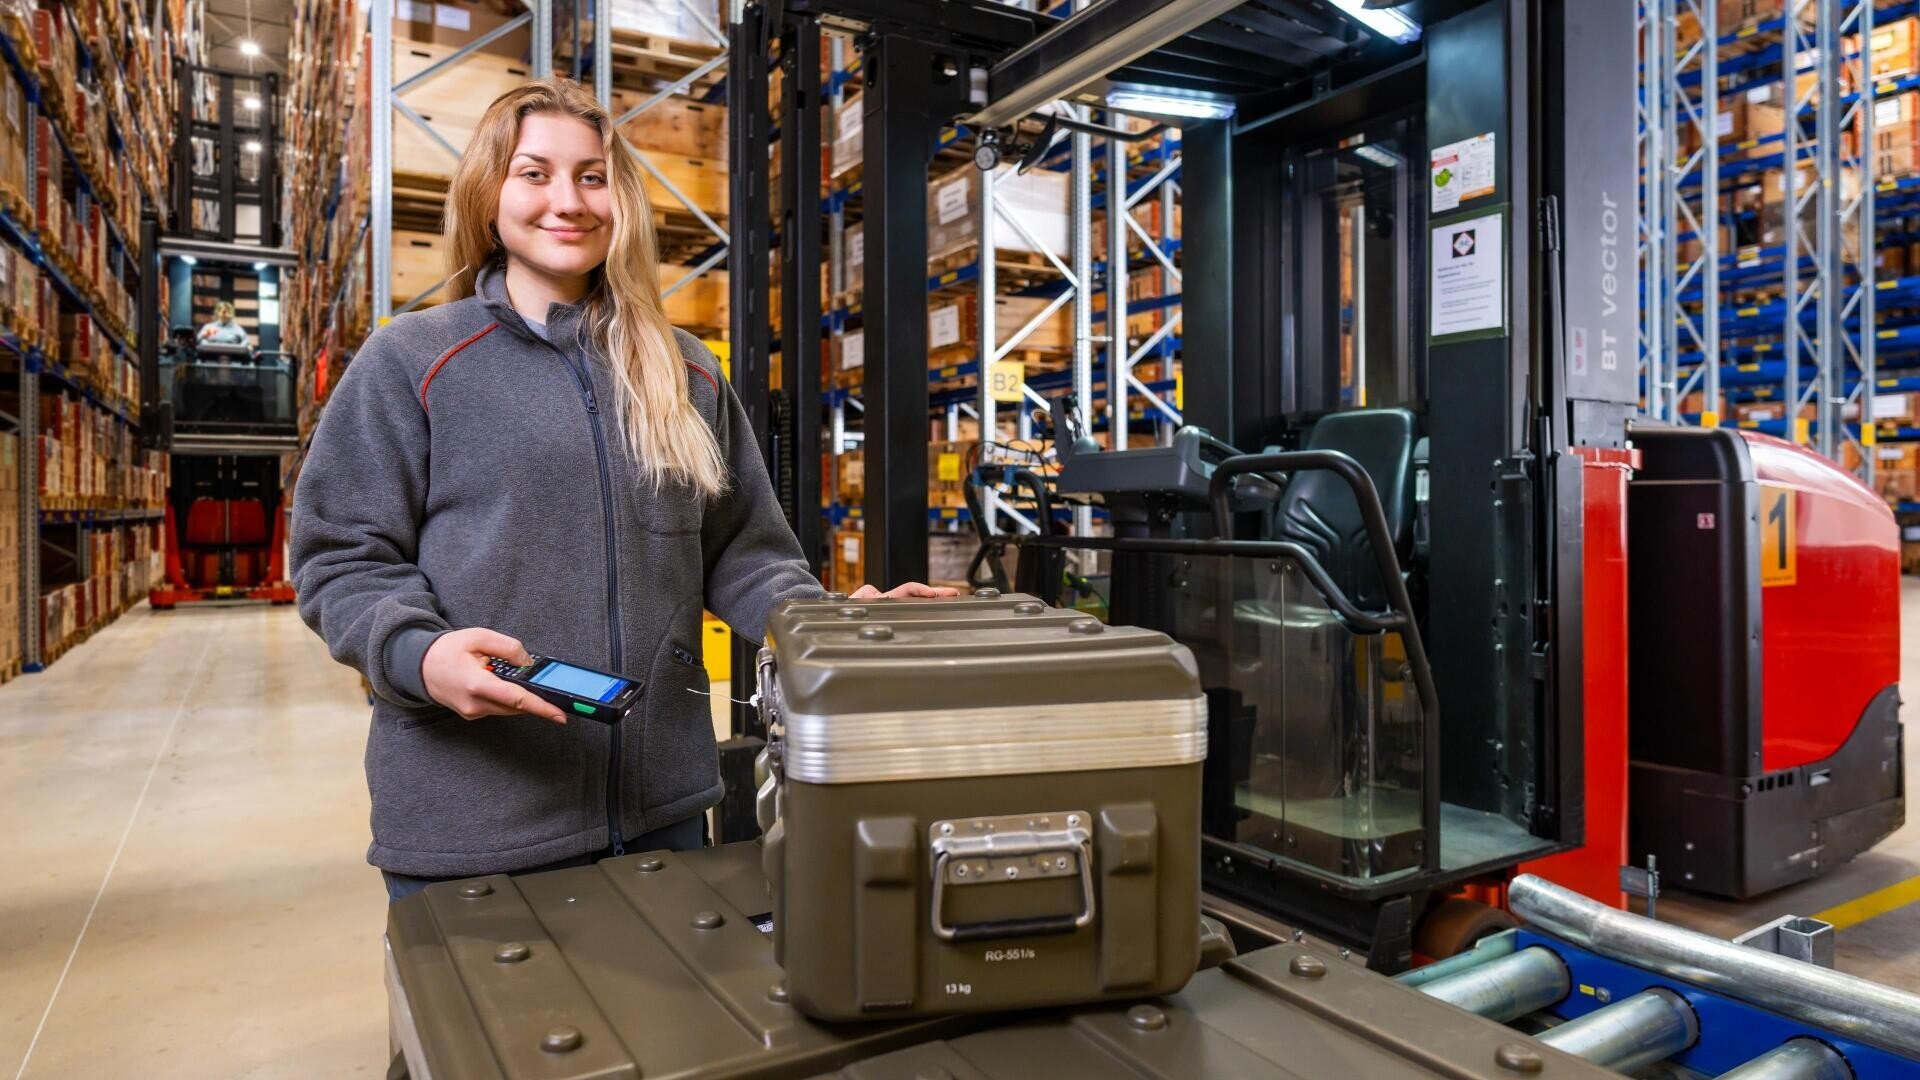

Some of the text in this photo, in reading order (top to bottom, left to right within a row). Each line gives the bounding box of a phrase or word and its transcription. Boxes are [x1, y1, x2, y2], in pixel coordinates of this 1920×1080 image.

[1601, 191, 1618, 371] BT vector
[994, 373, 1018, 391] B2
[1769, 493, 1786, 569] 1
[945, 983, 971, 994] 13 kg
